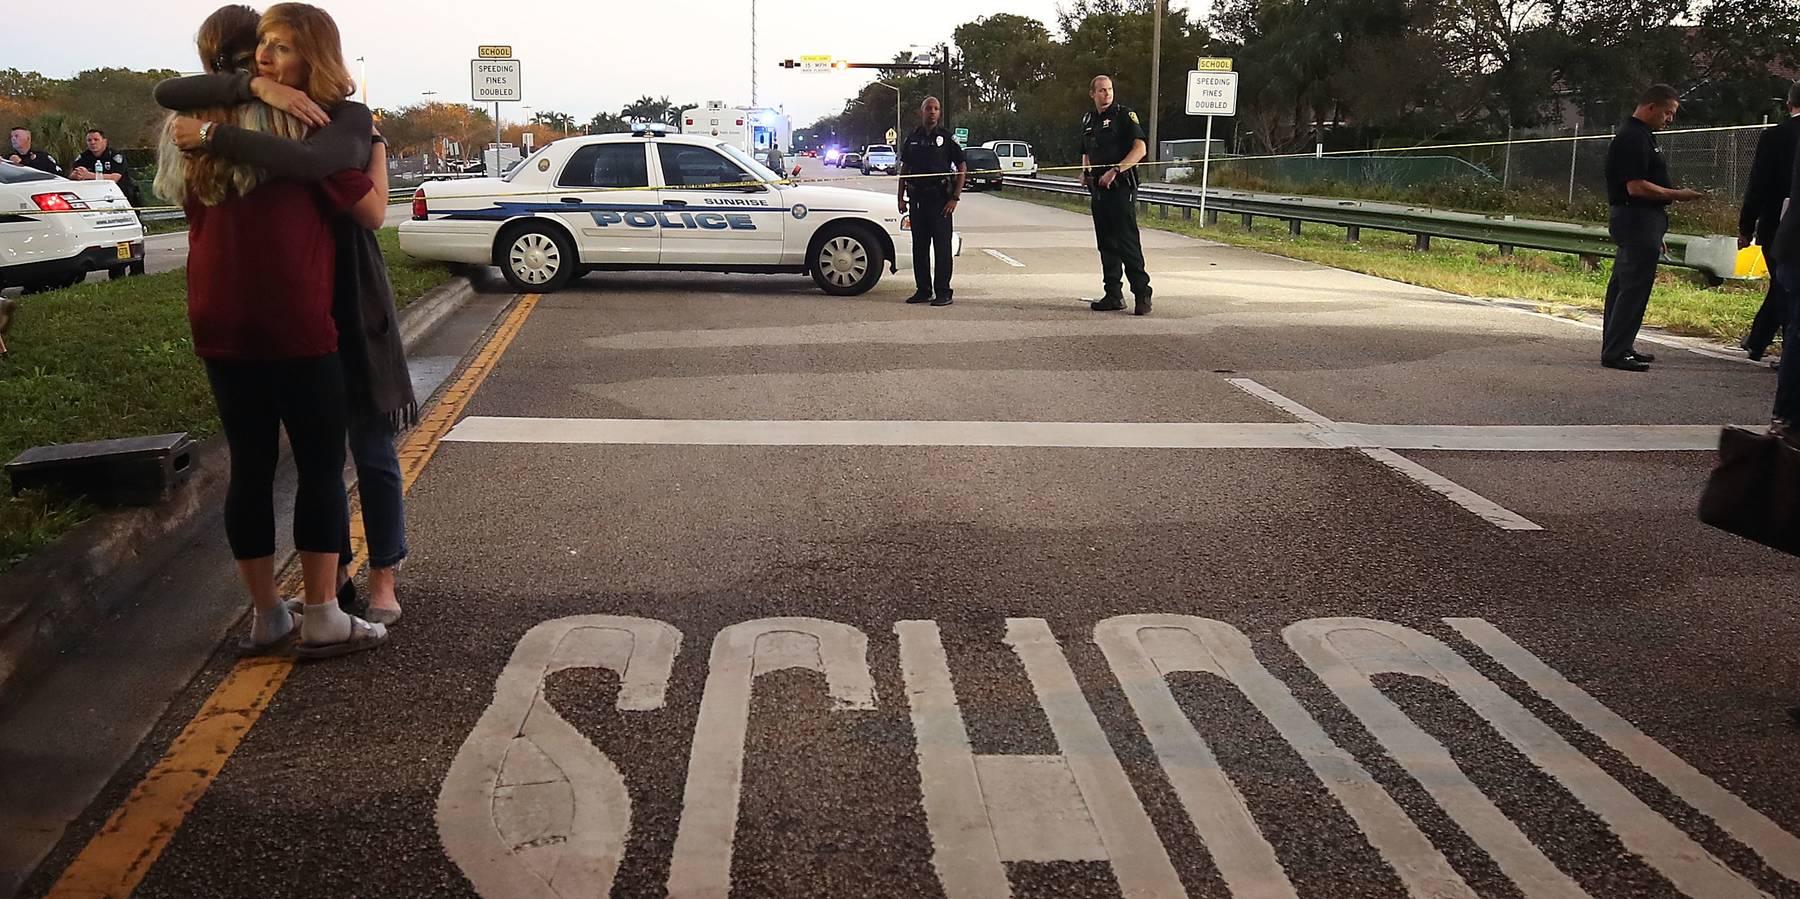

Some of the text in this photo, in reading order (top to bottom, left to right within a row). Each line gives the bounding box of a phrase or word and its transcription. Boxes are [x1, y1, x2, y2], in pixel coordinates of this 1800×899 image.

[480, 48, 510, 56] SCHOOL
[1201, 60, 1230, 69] SCHOOL
[1196, 78, 1230, 86] SPEEDING
[1202, 89, 1223, 97] FINES
[1195, 100, 1228, 109] DOUBLED
[703, 198, 769, 207] SUNRISE
[589, 210, 758, 230] POLICE
